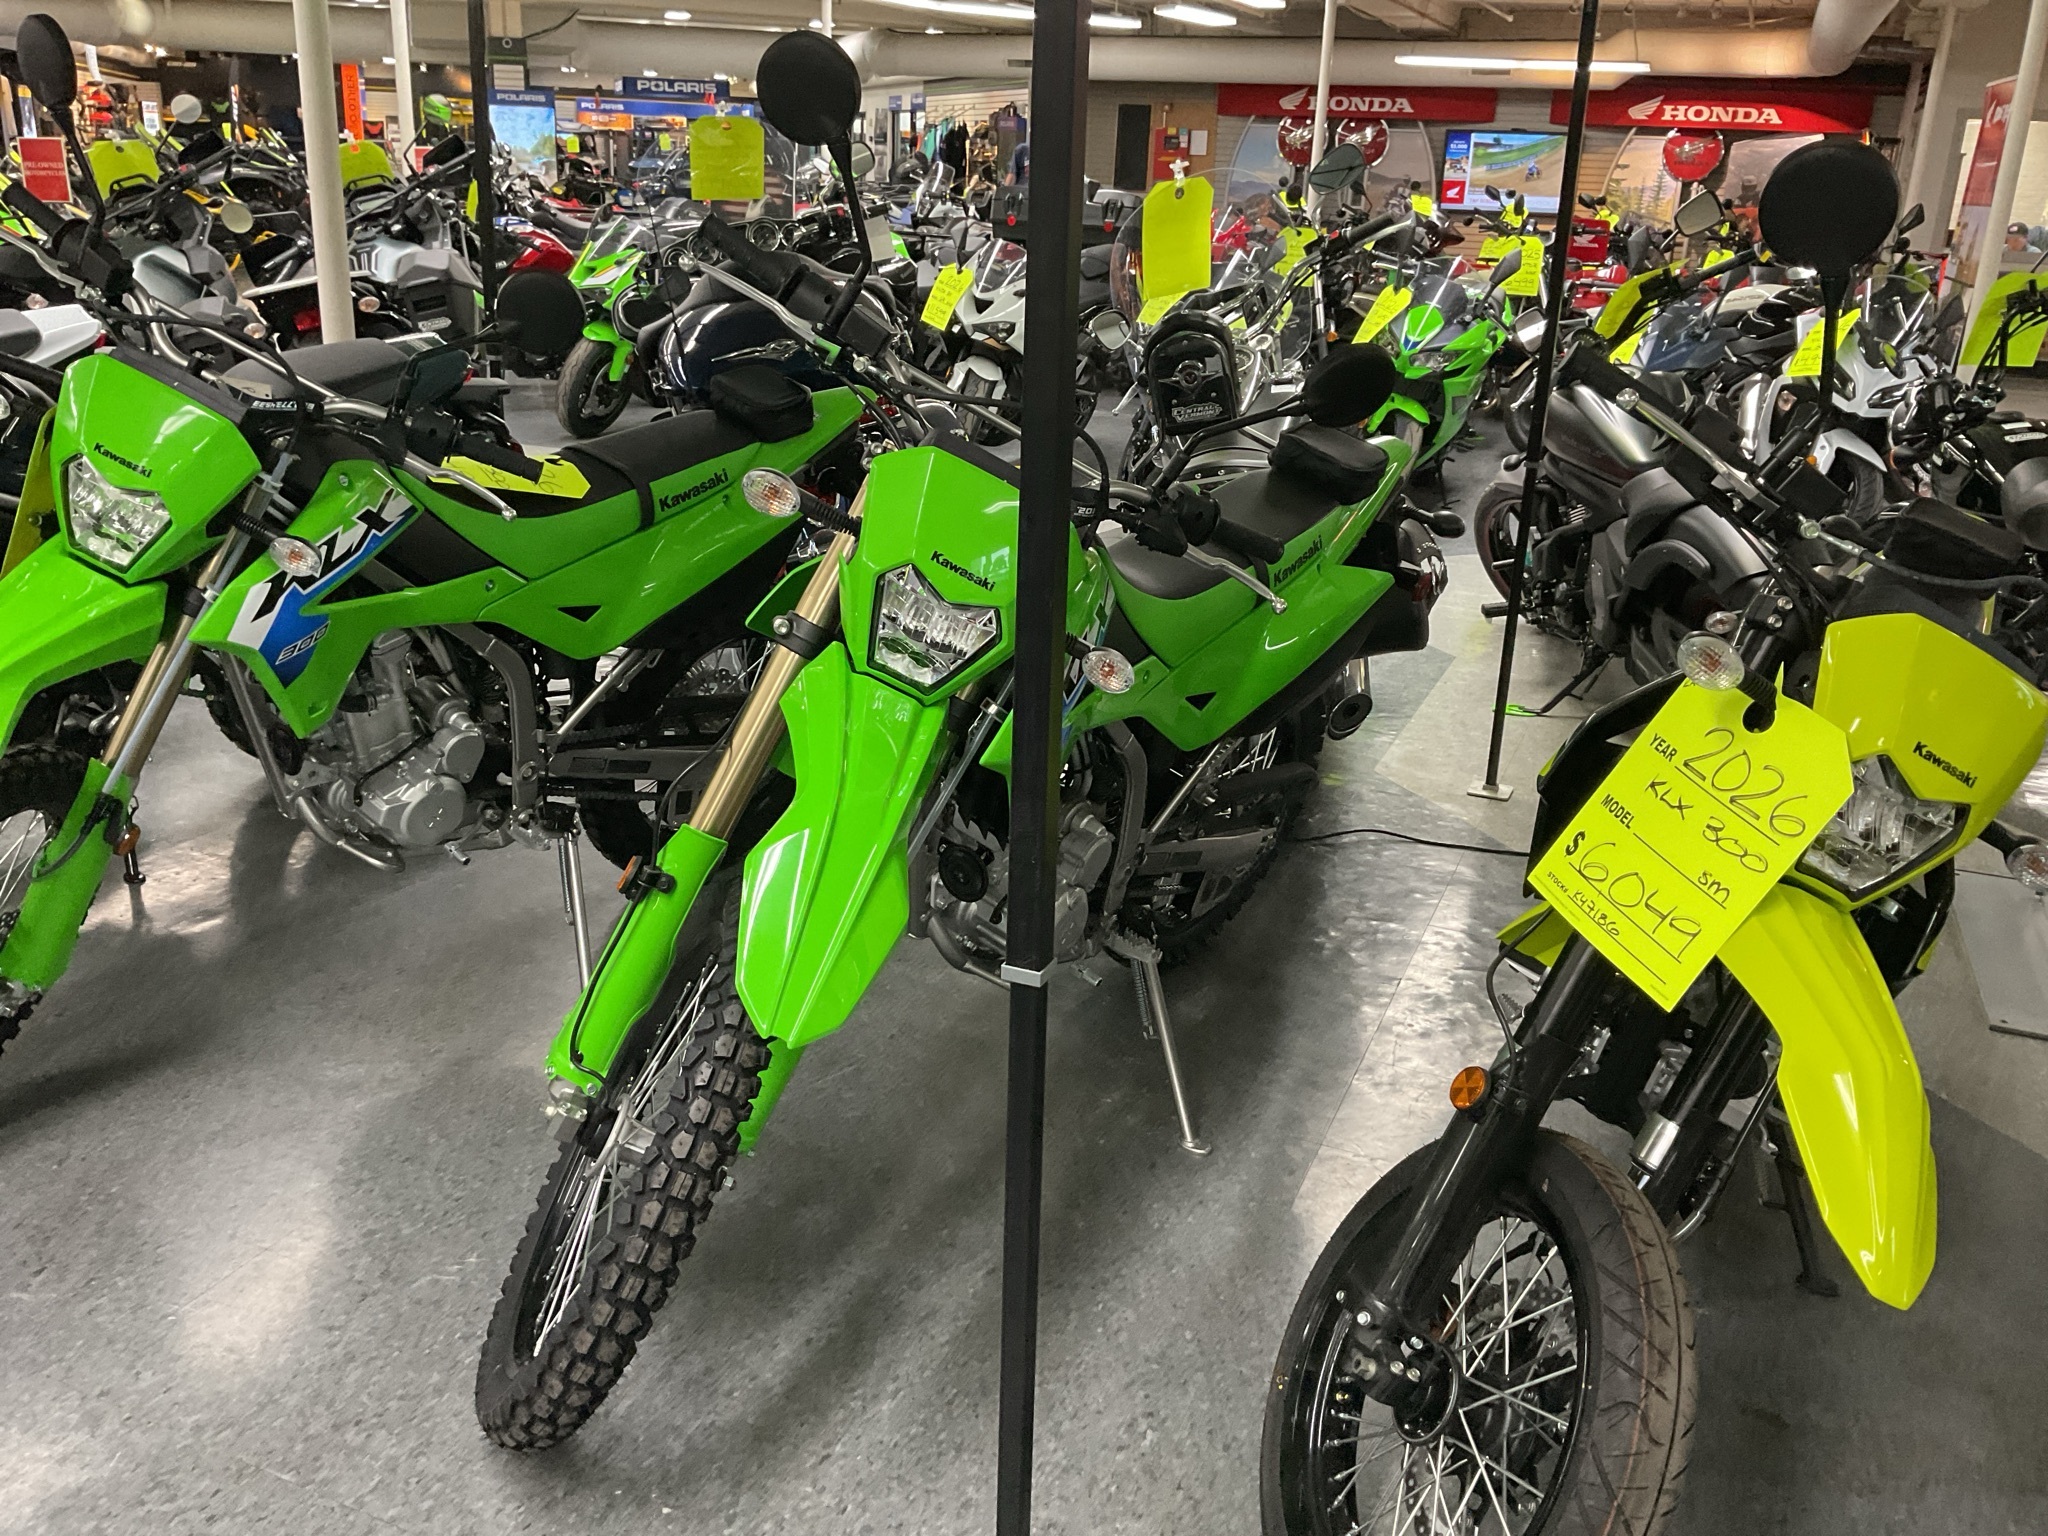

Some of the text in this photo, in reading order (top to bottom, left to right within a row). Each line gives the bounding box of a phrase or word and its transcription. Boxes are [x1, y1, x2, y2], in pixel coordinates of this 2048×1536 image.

[496, 93, 546, 102] POLARIS
[637, 80, 717, 94] POLARIS
[581, 102, 624, 110] POARIS
[1661, 105, 1783, 124] HONDA
[93, 442, 153, 478] Kawasaki
[659, 467, 729, 512] Kawasaki
[930, 550, 996, 591] Kawasaki
[1273, 534, 1322, 587] Kawasaki
[1650, 727, 1808, 837] YEAR 2026
[1912, 741, 1978, 789] Kawasaki
[1601, 794, 1635, 829] MODEL
[1645, 774, 1768, 873] KLX 300
[1547, 871, 1569, 894] STOCK#
